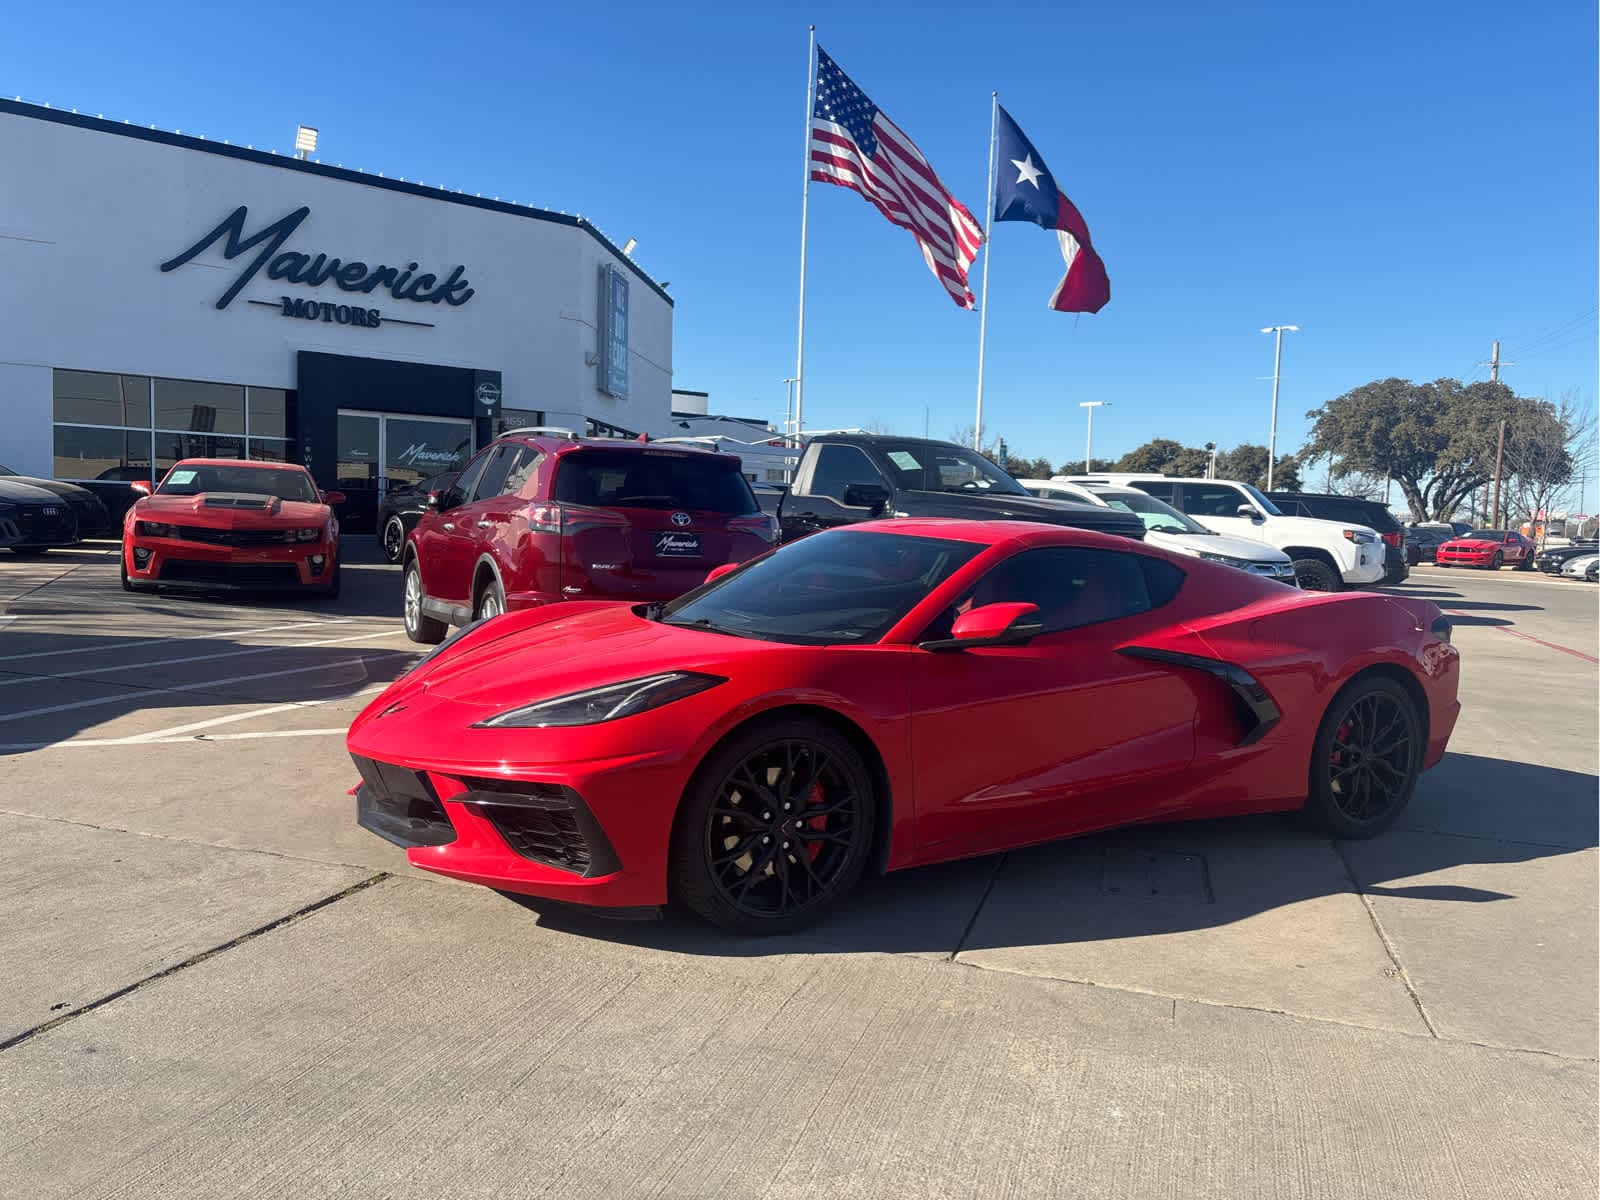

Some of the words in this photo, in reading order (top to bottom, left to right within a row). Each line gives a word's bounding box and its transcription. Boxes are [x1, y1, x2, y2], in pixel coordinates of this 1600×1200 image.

[160, 205, 475, 310] Maverick
[281, 296, 381, 328] MOTORS
[398, 442, 460, 465] Maverick
